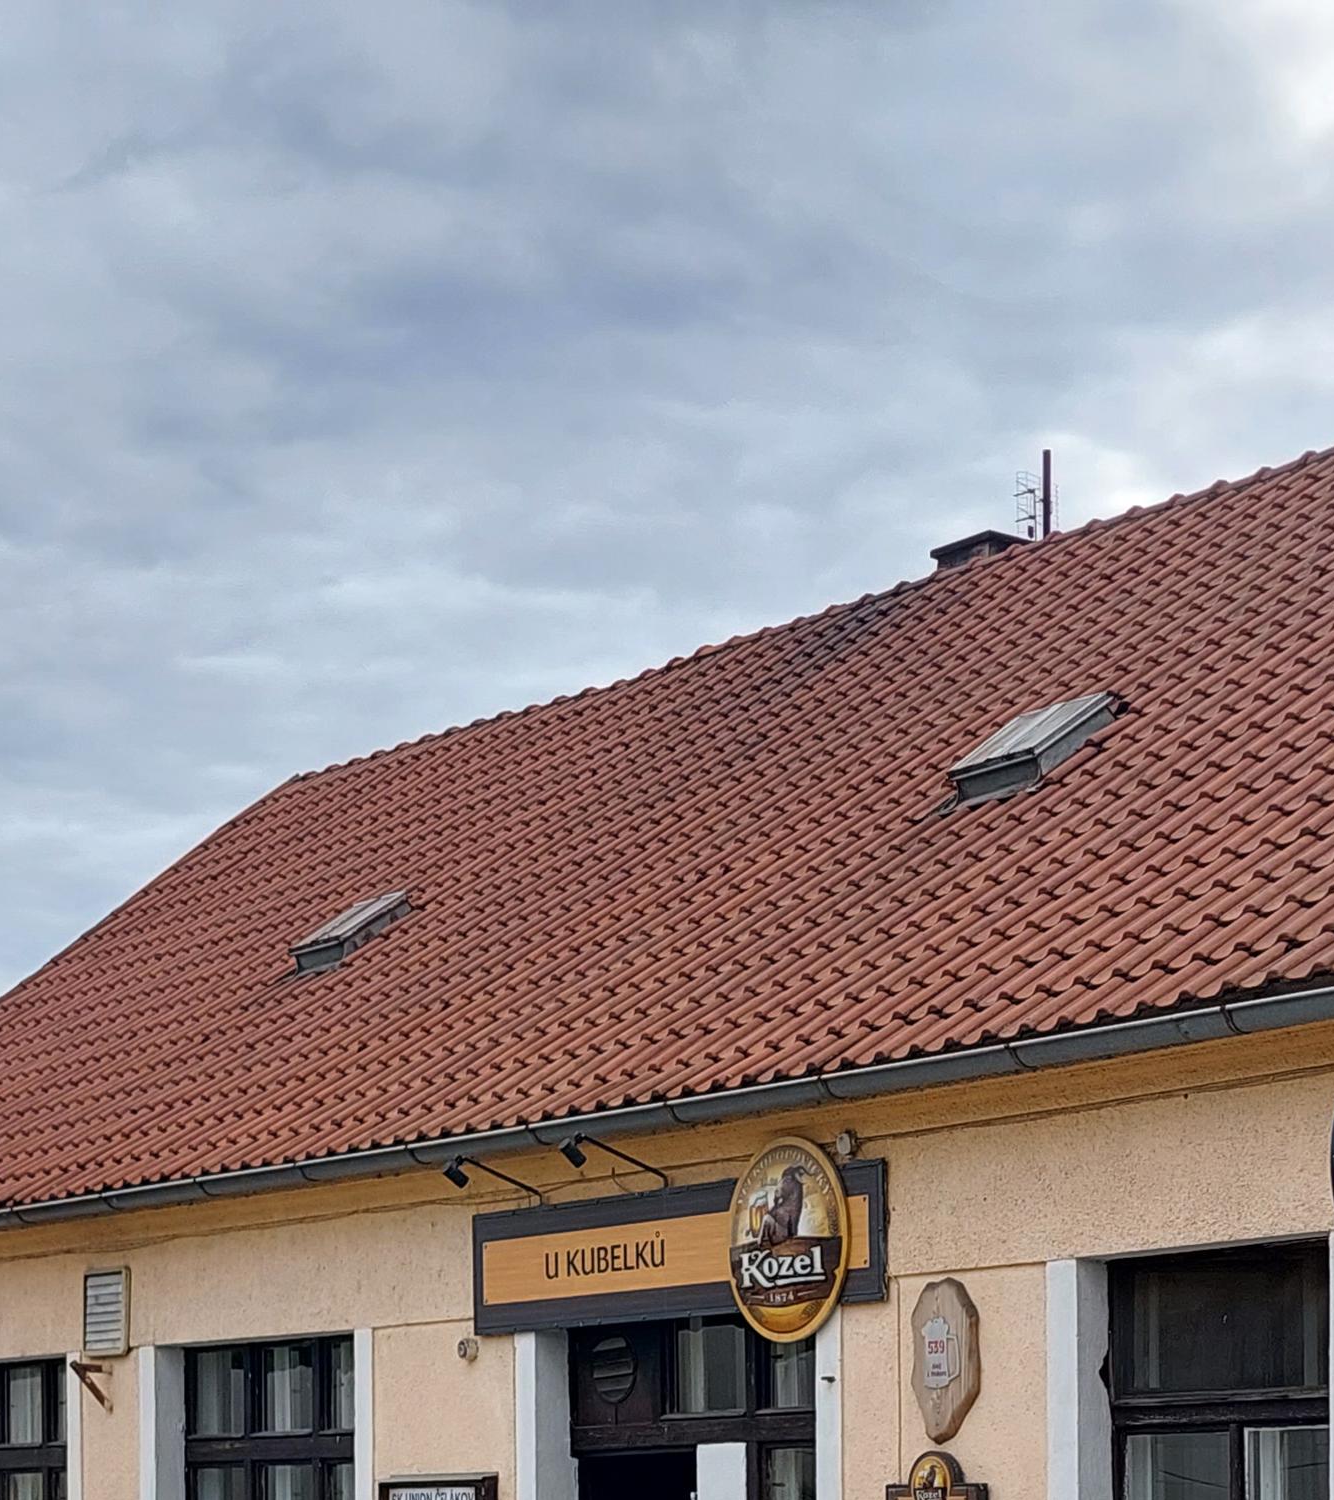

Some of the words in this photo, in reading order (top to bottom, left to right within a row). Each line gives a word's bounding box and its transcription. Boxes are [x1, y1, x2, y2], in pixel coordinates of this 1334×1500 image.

[545, 1251, 559, 1280] U
[566, 1230, 665, 1277] KUBELKŮ
[740, 1245, 826, 1288] Kozel
[769, 1291, 794, 1302] 1874
[927, 1340, 945, 1355] 539
